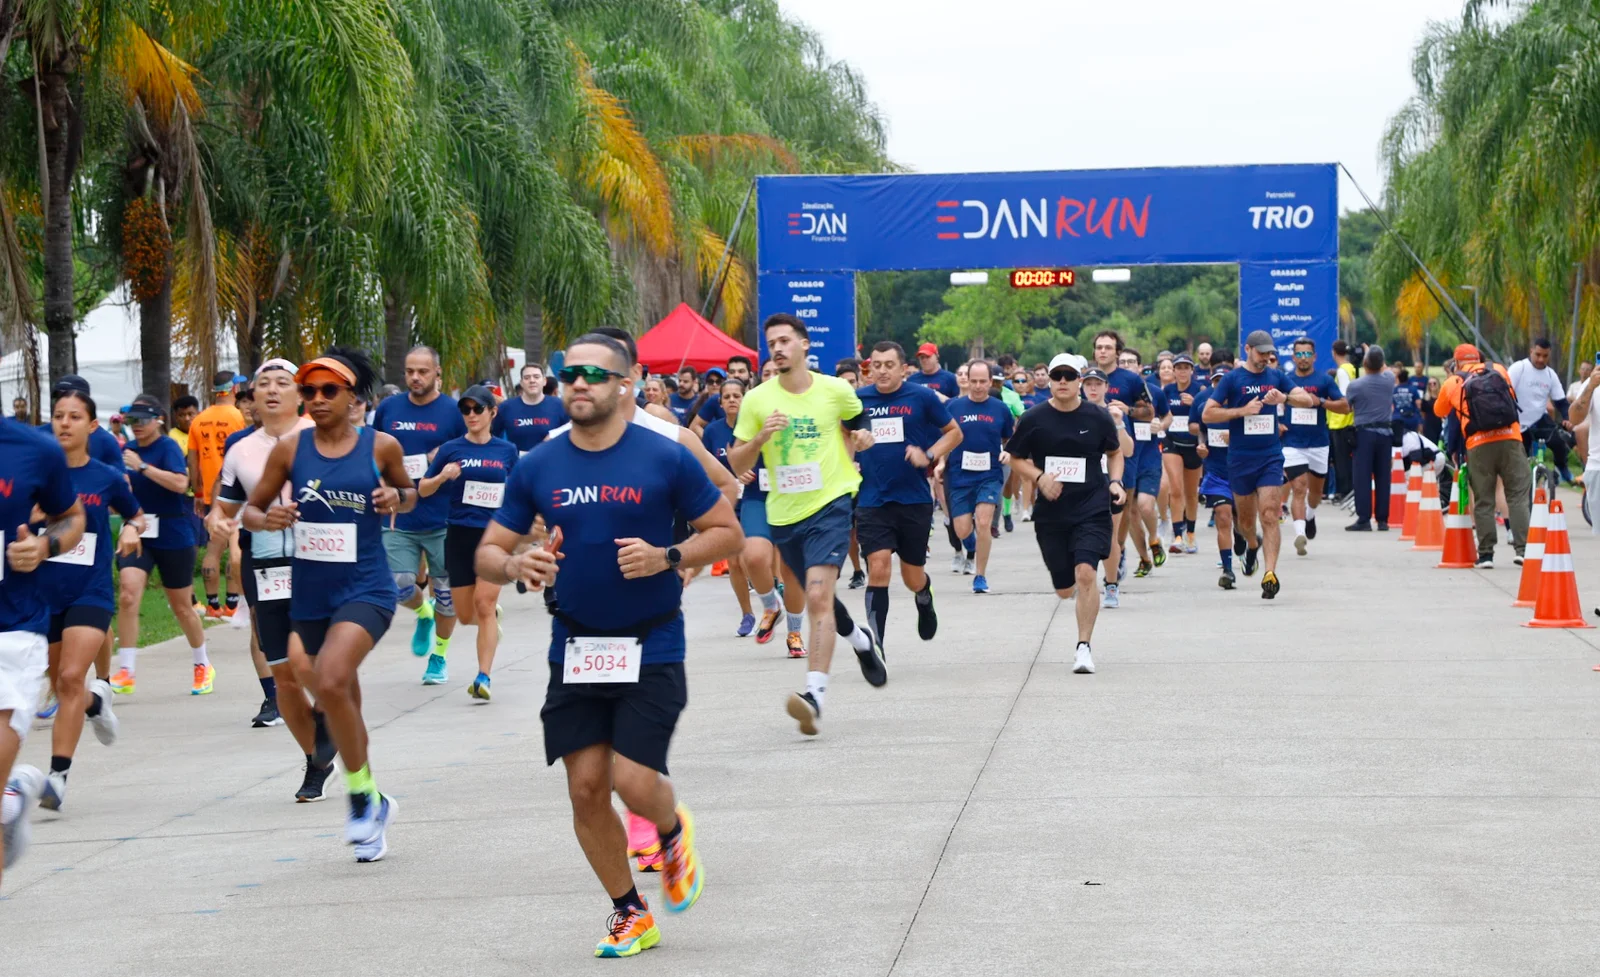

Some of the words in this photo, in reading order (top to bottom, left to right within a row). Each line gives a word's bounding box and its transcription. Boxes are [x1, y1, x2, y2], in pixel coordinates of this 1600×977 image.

[936, 198, 1048, 239] EDAN
[1055, 195, 1152, 239] RUN
[1248, 205, 1314, 230] TRIO
[788, 213, 847, 235] EDAN
[1270, 269, 1308, 277] GRAB&GO
[1273, 283, 1304, 291] RunFun
[792, 294, 822, 303] RunFun
[889, 406, 912, 415] RUN
[392, 421, 416, 431] EDAN
[416, 422, 438, 432] RUN
[514, 418, 533, 427] EDAN
[533, 417, 550, 426] RUN
[873, 427, 897, 438] 5043
[482, 460, 504, 470] RUN
[1056, 466, 1078, 477] 5127
[787, 473, 813, 487] 5103
[475, 490, 498, 502] 5016
[552, 485, 598, 508] EDAN
[600, 484, 642, 504] RUN
[308, 538, 345, 552] 5002
[584, 655, 628, 671] 5034
